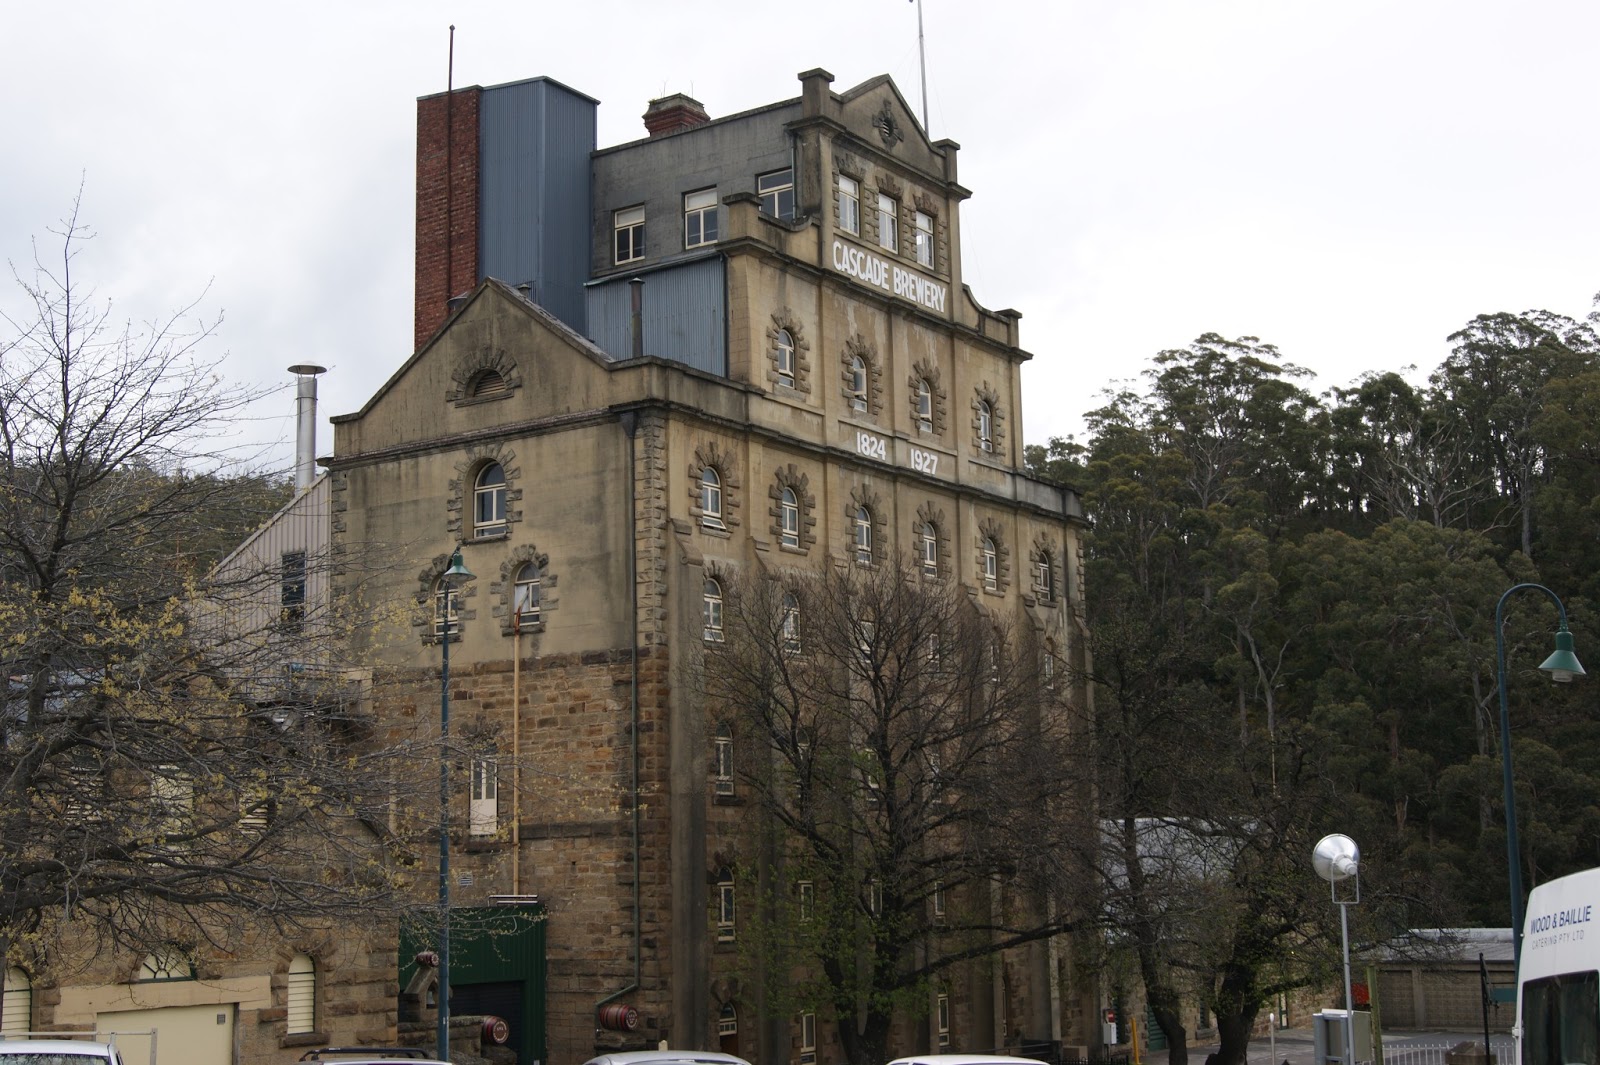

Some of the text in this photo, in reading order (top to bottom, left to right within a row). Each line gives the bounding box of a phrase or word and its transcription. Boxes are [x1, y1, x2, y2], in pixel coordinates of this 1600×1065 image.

[833, 241, 946, 313] CASCADE BREWERY
[857, 432, 886, 460] 1824
[911, 448, 938, 475] 1927
[1530, 905, 1592, 935] WOOD & BAILLIE
[1572, 929, 1585, 941] LTD
